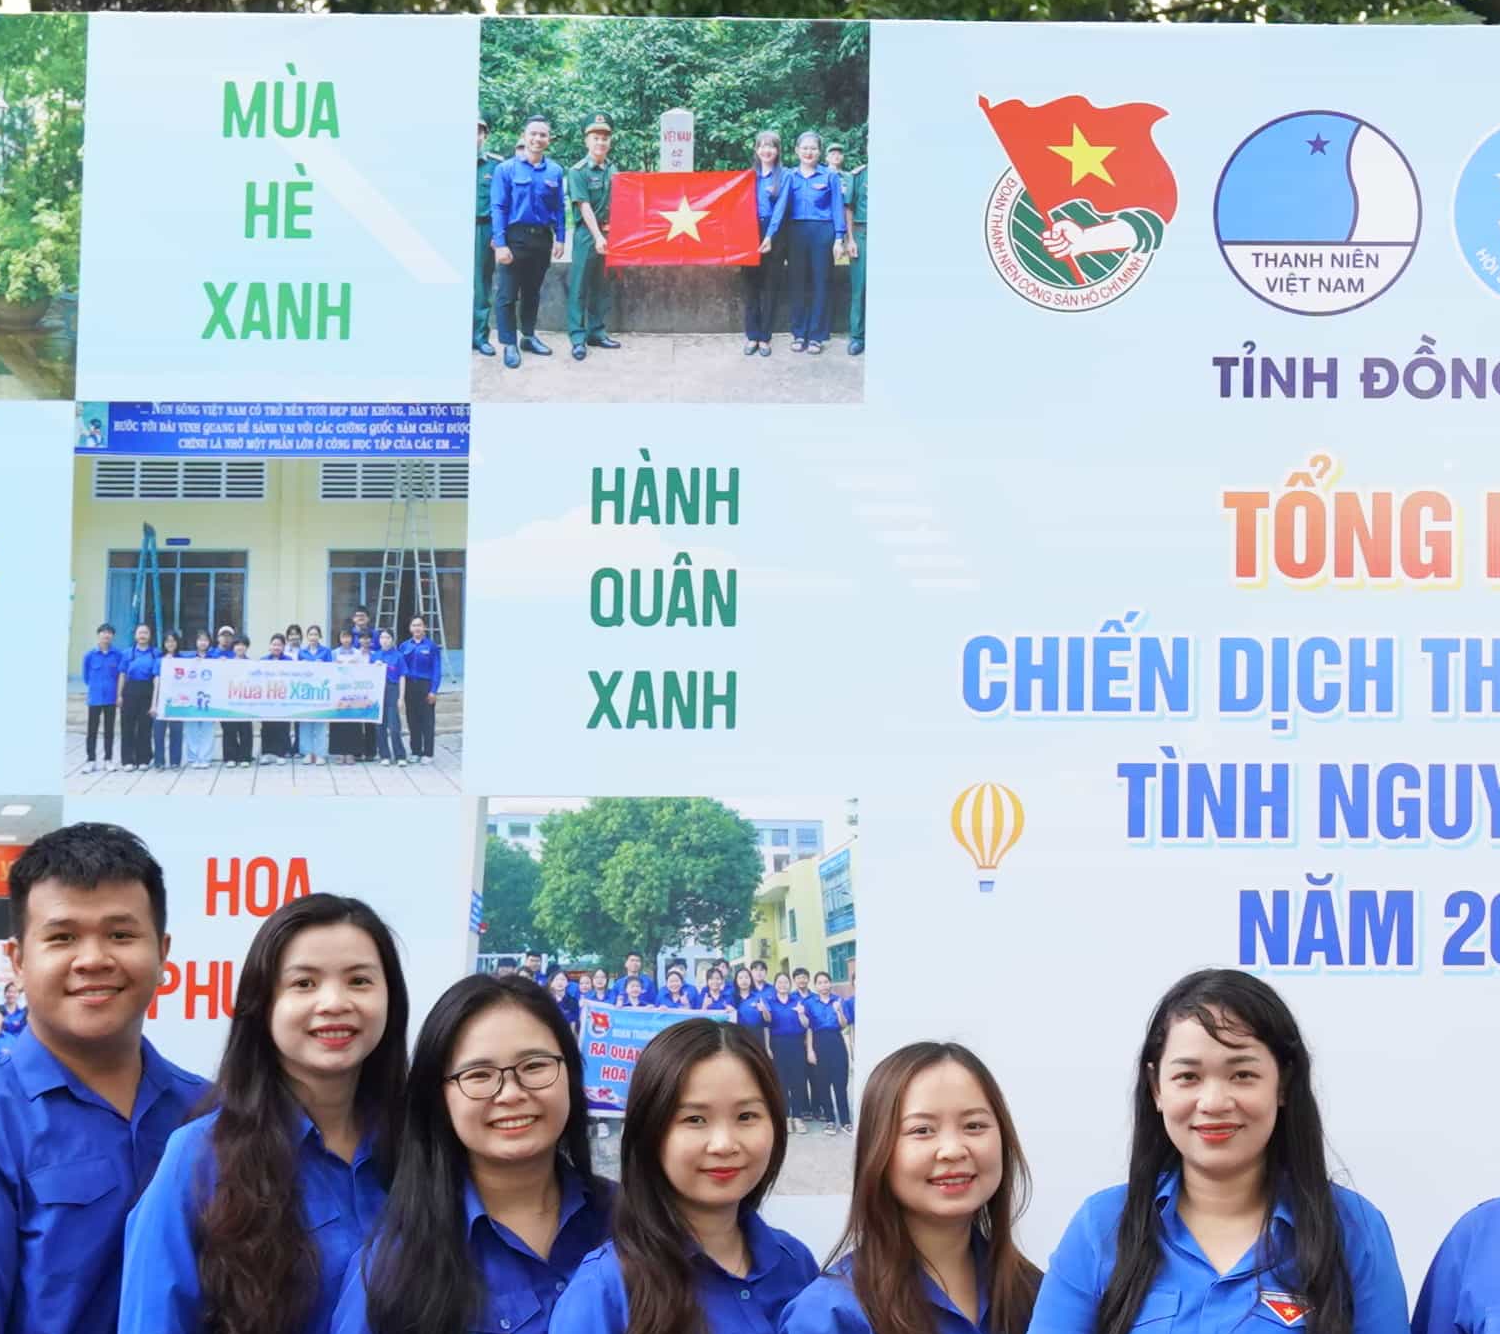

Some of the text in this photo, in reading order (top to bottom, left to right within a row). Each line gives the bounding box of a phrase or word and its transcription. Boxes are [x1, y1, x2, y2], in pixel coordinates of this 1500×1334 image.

[223, 63, 339, 138] MÙA
[245, 163, 313, 239] HÈ
[1117, 256, 1145, 285] MINH
[1252, 249, 1379, 268] THANH NIÊN
[1265, 273, 1364, 296] VIỆT NAM
[1476, 248, 1498, 275] HỘI
[202, 282, 351, 340] XANH
[1213, 341, 1337, 398] TỈNH
[592, 448, 739, 525] HÀNH
[1224, 456, 1451, 579] TỔNG
[591, 552, 736, 627] QUÂN
[587, 671, 736, 729] XANH
[963, 611, 1188, 712] CHIẾN
[1219, 637, 1393, 730] DỊCH
[1117, 746, 1288, 838] TÌNH
[206, 856, 311, 917] HOA
[1240, 873, 1413, 965] NĂM
[602, 1066, 628, 1081] HOA
